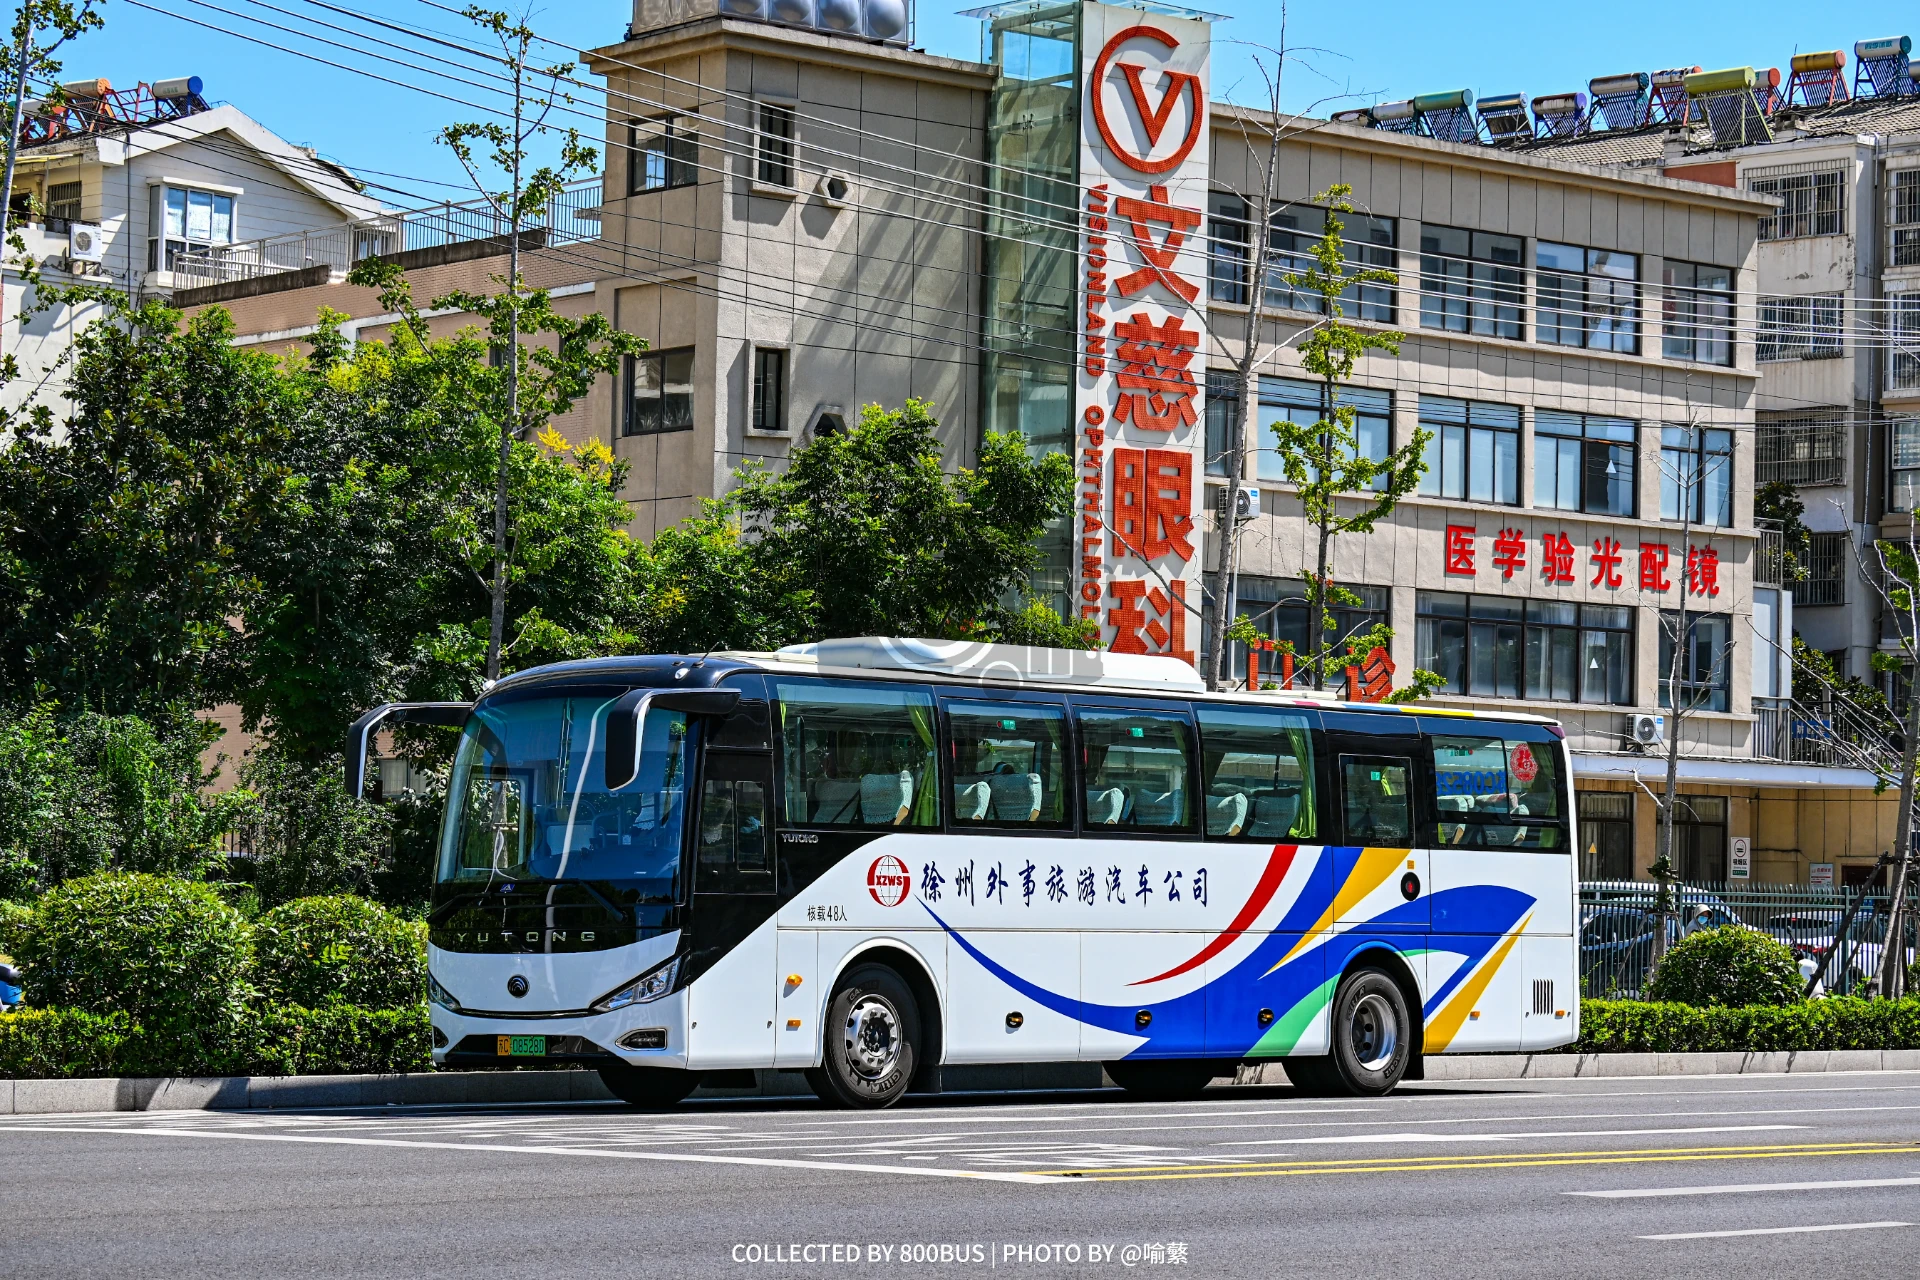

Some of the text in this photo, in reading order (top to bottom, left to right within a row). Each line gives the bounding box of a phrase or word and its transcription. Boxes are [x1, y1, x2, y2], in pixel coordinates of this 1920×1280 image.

[1086, 183, 1108, 378] VISIONLAND
[1108, 185, 1202, 667] 文慈眼科
[1445, 524, 1720, 597] 医学验光配镜
[875, 875, 903, 886] XZWS
[921, 859, 1208, 908] 徐州外事旅游汽车公司
[457, 931, 596, 942] YUTONG
[807, 905, 848, 921] 核载48人
